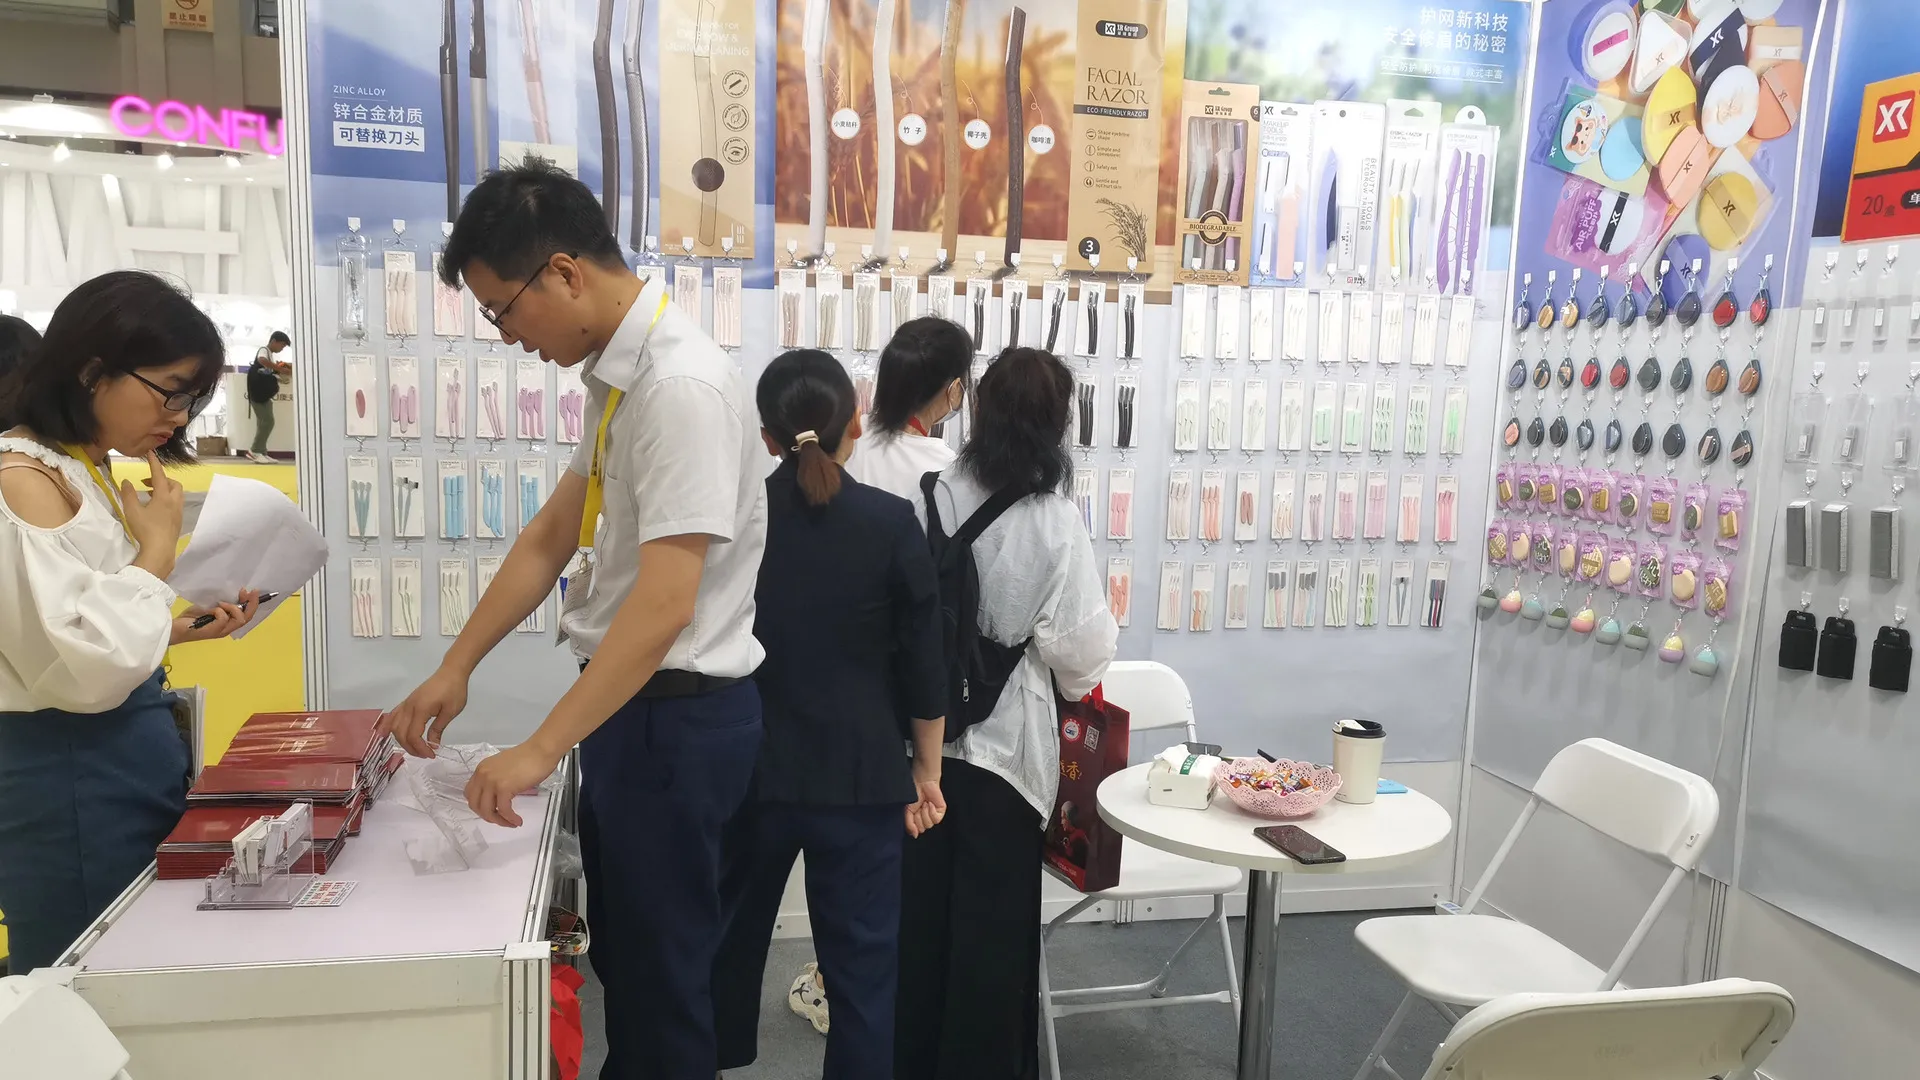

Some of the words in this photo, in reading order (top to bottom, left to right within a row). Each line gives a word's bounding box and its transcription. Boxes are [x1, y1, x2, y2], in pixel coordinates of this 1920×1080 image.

[1088, 67, 1142, 86] FACIAL
[333, 85, 355, 94] ZINC
[357, 87, 386, 96] ALLOY
[1087, 85, 1149, 104] RAZOR
[333, 102, 423, 125] 锌合金材质
[110, 95, 285, 156] CONFU
[339, 127, 420, 146] 可替换刀头
[1189, 224, 1236, 232] BIODEGRADABLE
[1575, 229, 1587, 251] AIR
[1582, 198, 1597, 228] PUFF
[1086, 240, 1094, 252] 3
